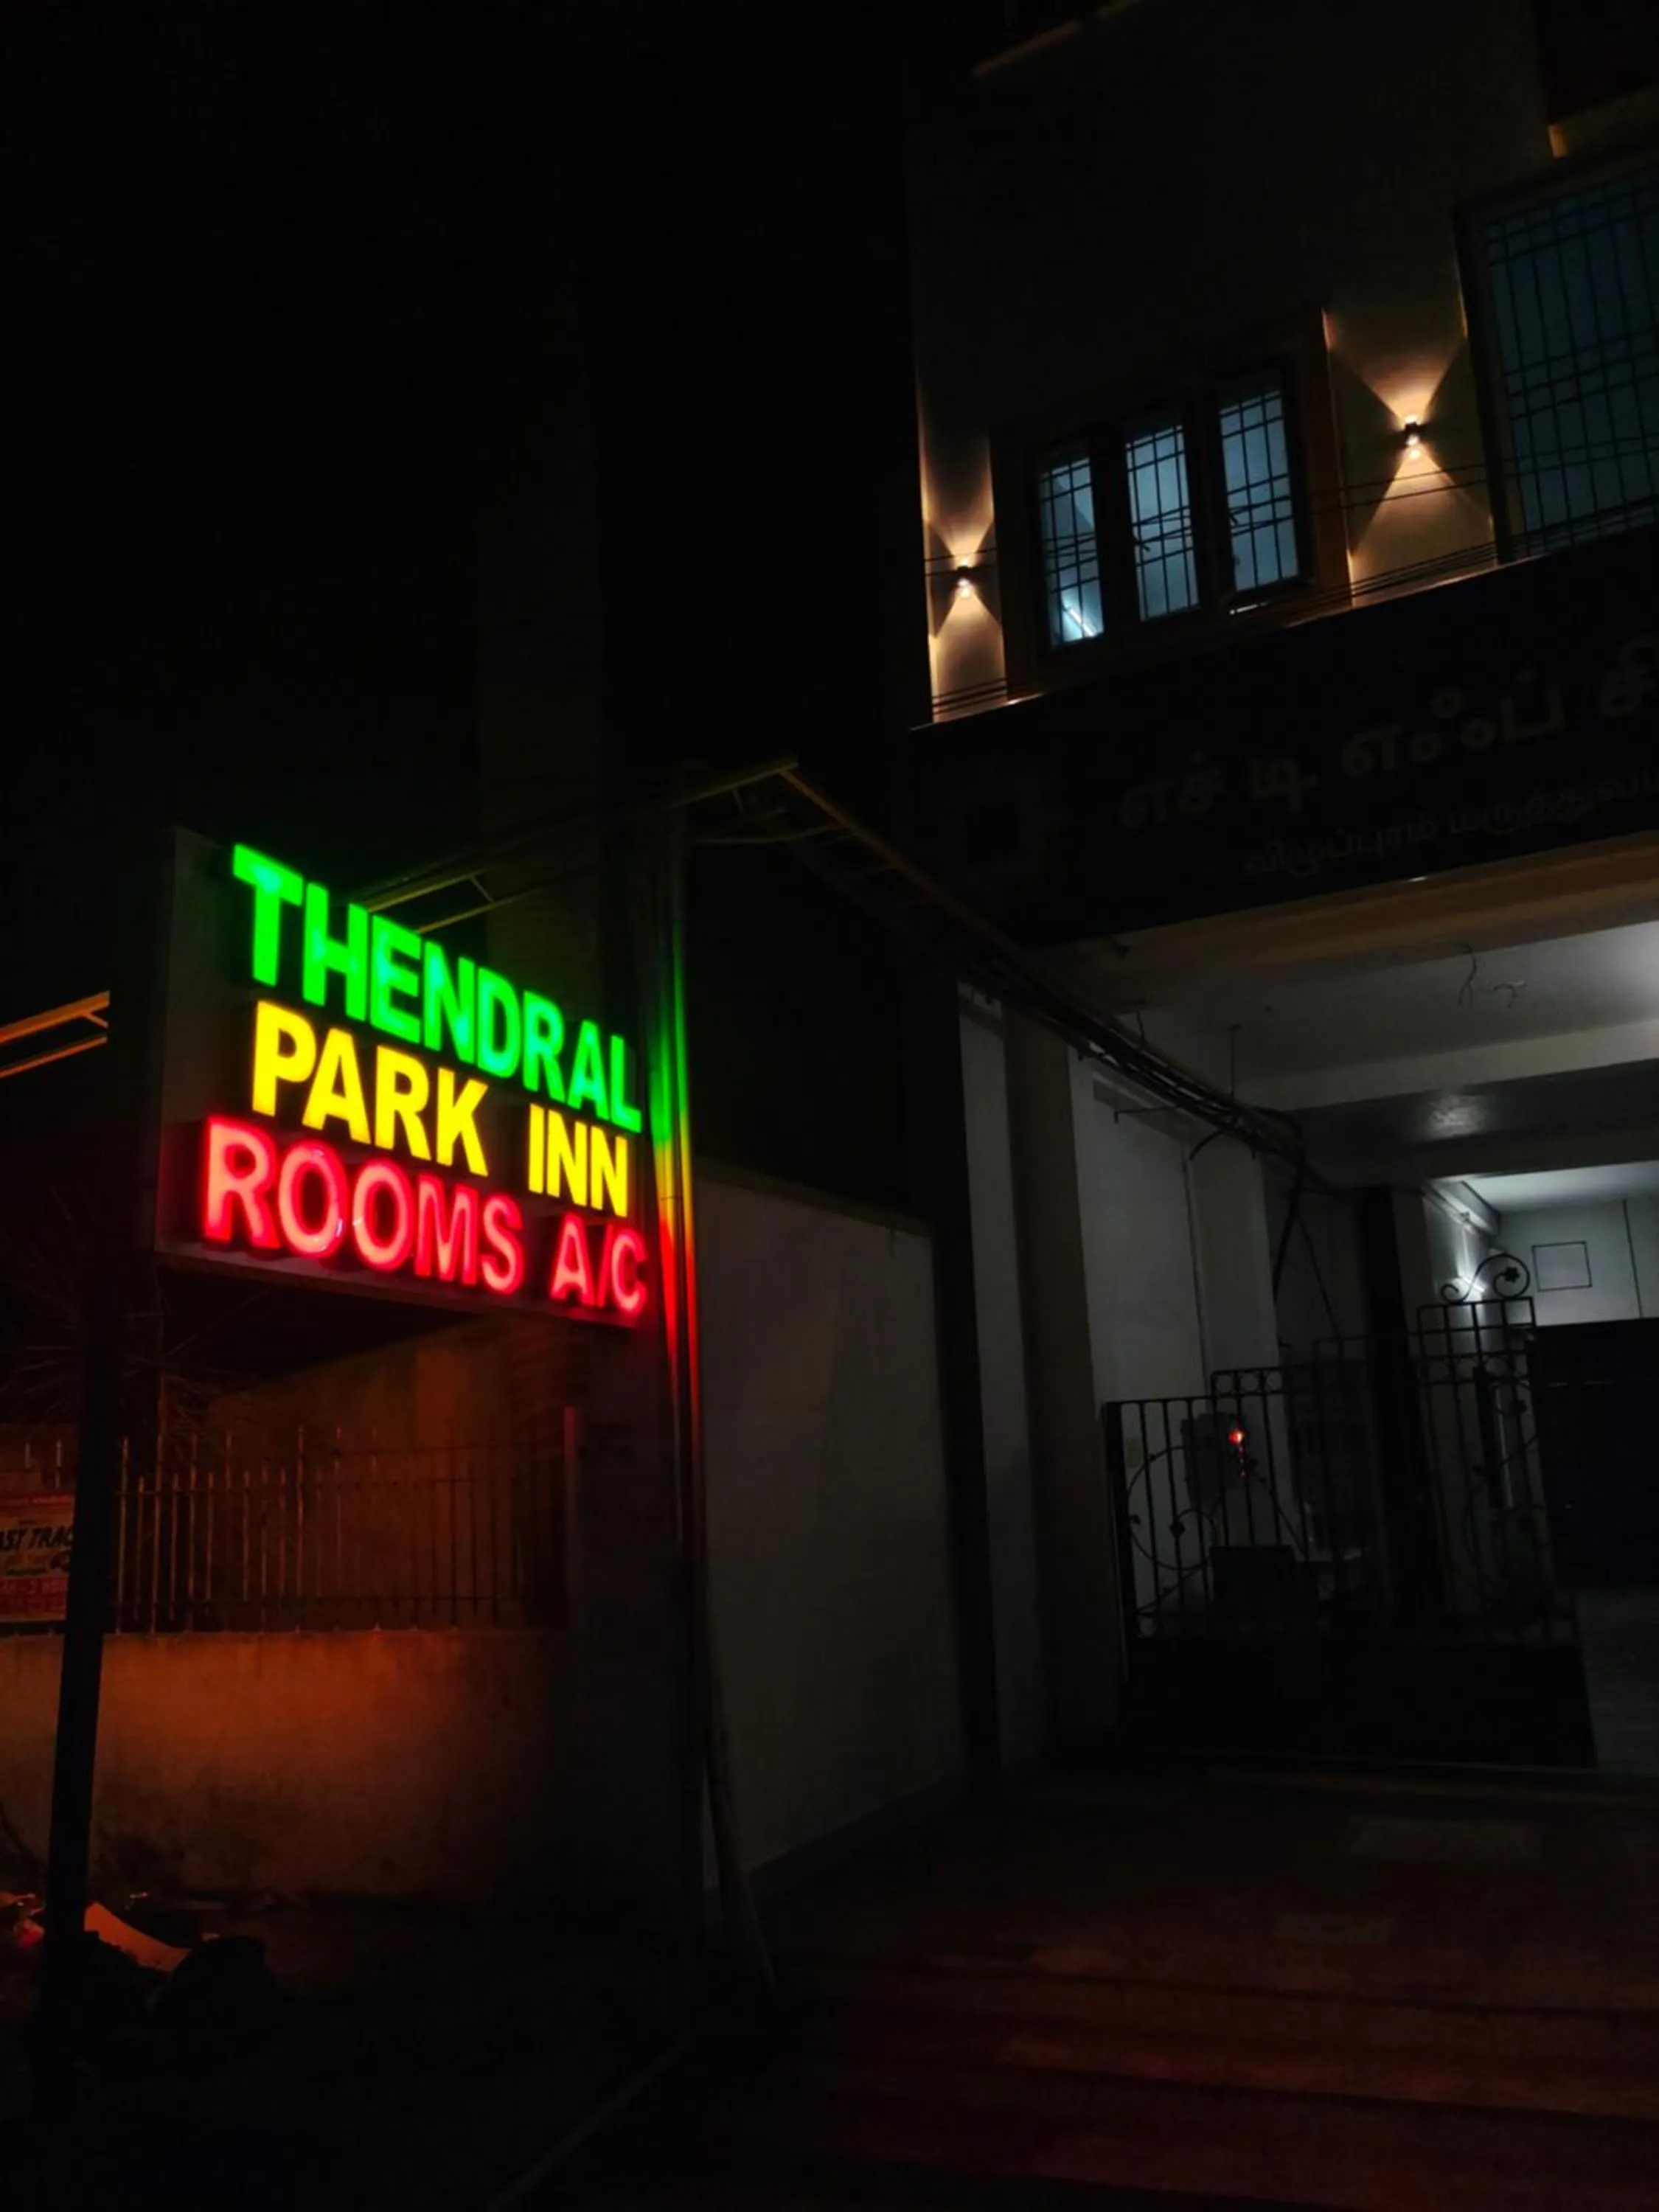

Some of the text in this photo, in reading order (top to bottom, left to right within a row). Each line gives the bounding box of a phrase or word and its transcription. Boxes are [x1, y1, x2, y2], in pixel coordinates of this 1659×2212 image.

[232, 843, 642, 1134] THENDRAL
[203, 1115, 648, 1315] ROOMS A/C
[251, 999, 628, 1218] PARK INN
